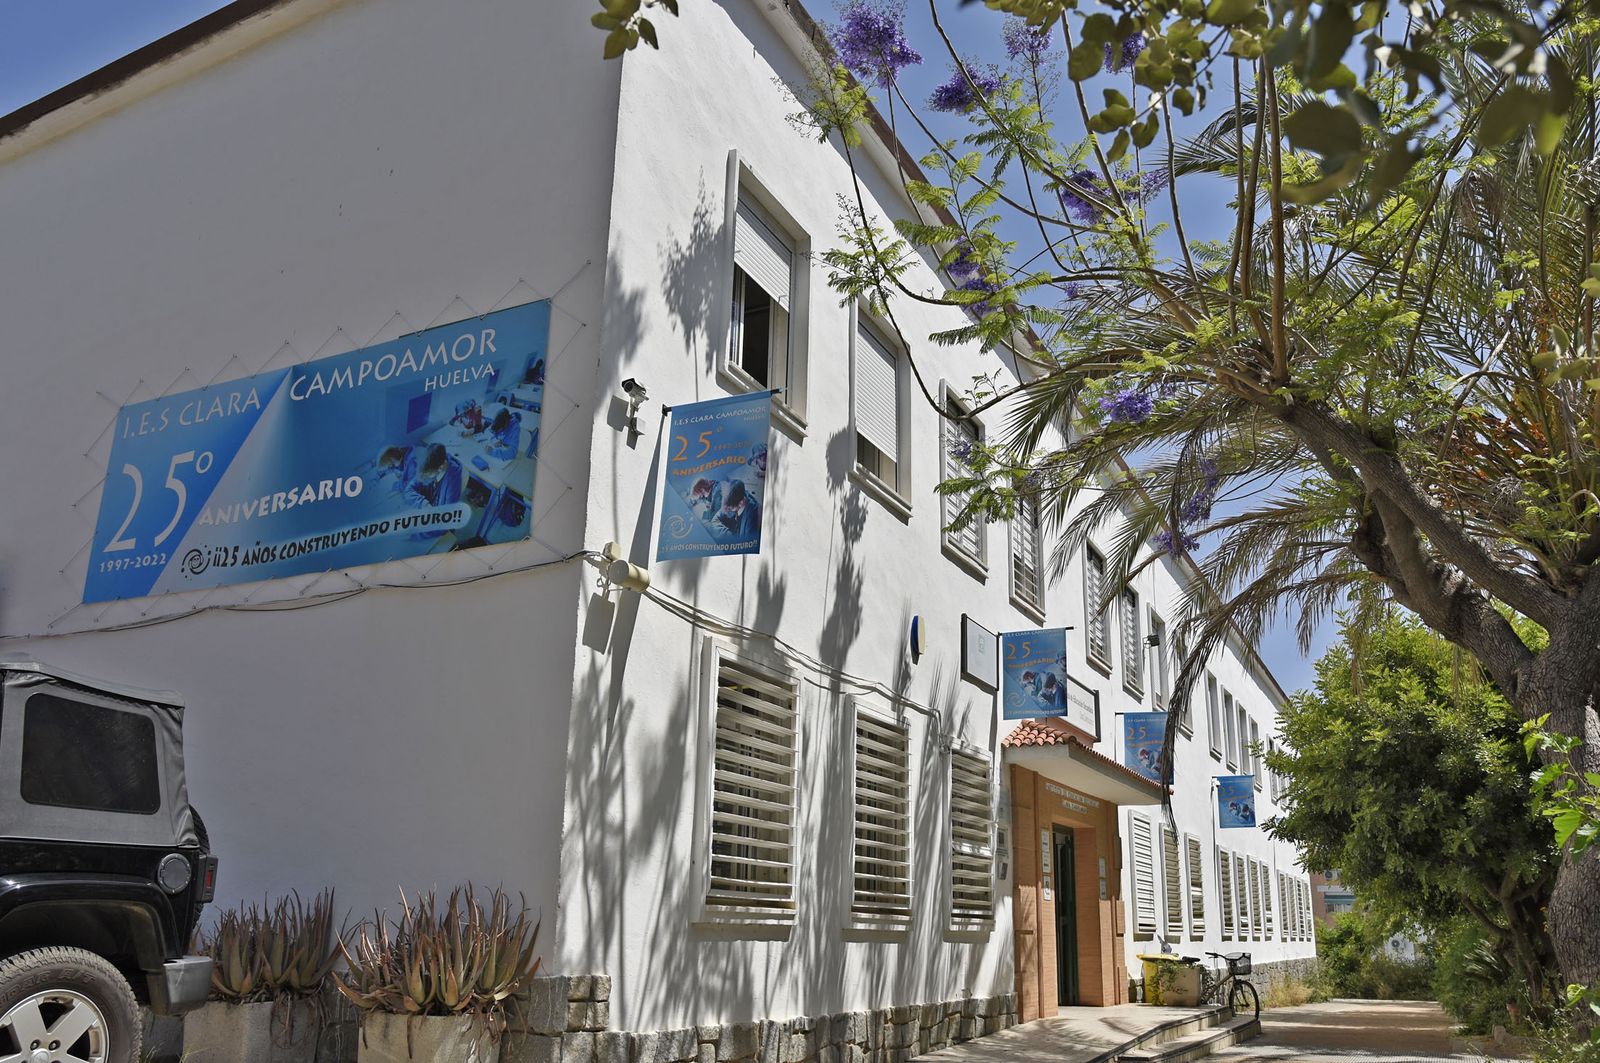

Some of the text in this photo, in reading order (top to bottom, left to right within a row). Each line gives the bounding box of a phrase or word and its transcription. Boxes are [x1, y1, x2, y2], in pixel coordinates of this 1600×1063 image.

[121, 328, 498, 440] I.E.S CLARA CAMPOAMOR
[424, 362, 496, 392] HUELVA
[690, 414, 714, 423] CLARA
[672, 455, 747, 476] ANIVERSARIO
[199, 475, 363, 527] ANIVERSARIO
[241, 541, 277, 567] AÑOS
[279, 521, 390, 561] CONSTRUYENDO
[393, 510, 463, 535] FUTURO!!
[99, 552, 168, 573] 1997-2022
